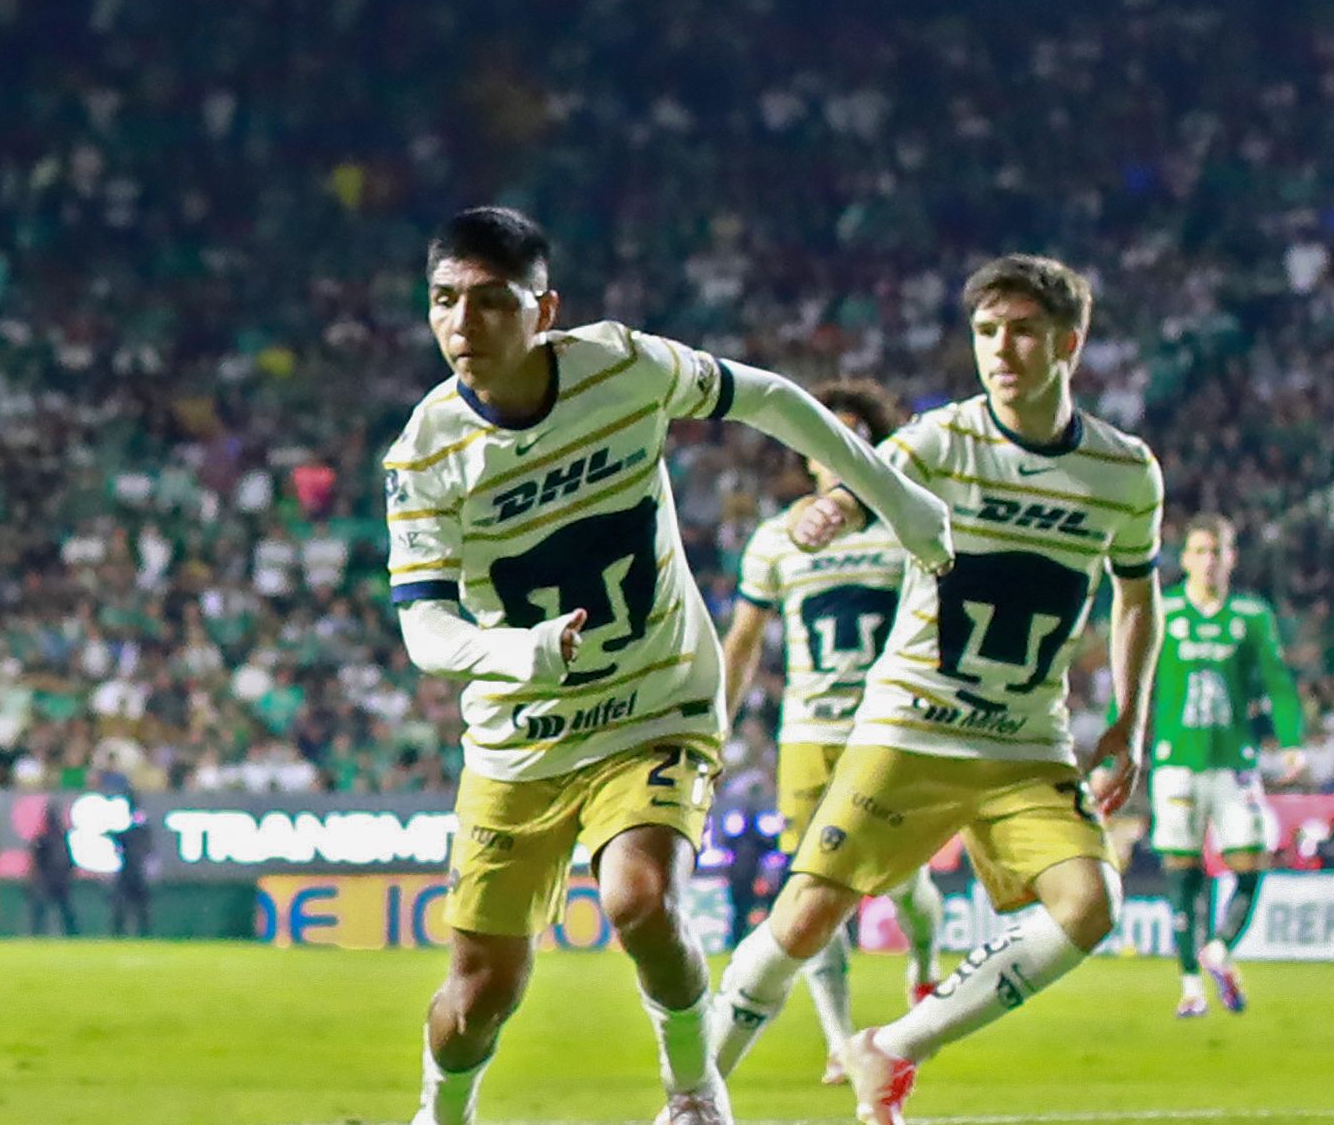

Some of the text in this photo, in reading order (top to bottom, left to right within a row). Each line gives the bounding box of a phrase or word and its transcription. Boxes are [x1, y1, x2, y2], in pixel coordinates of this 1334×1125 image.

[493, 447, 623, 523] DHL
[978, 496, 1099, 538] DHL
[569, 689, 638, 732] Mifel
